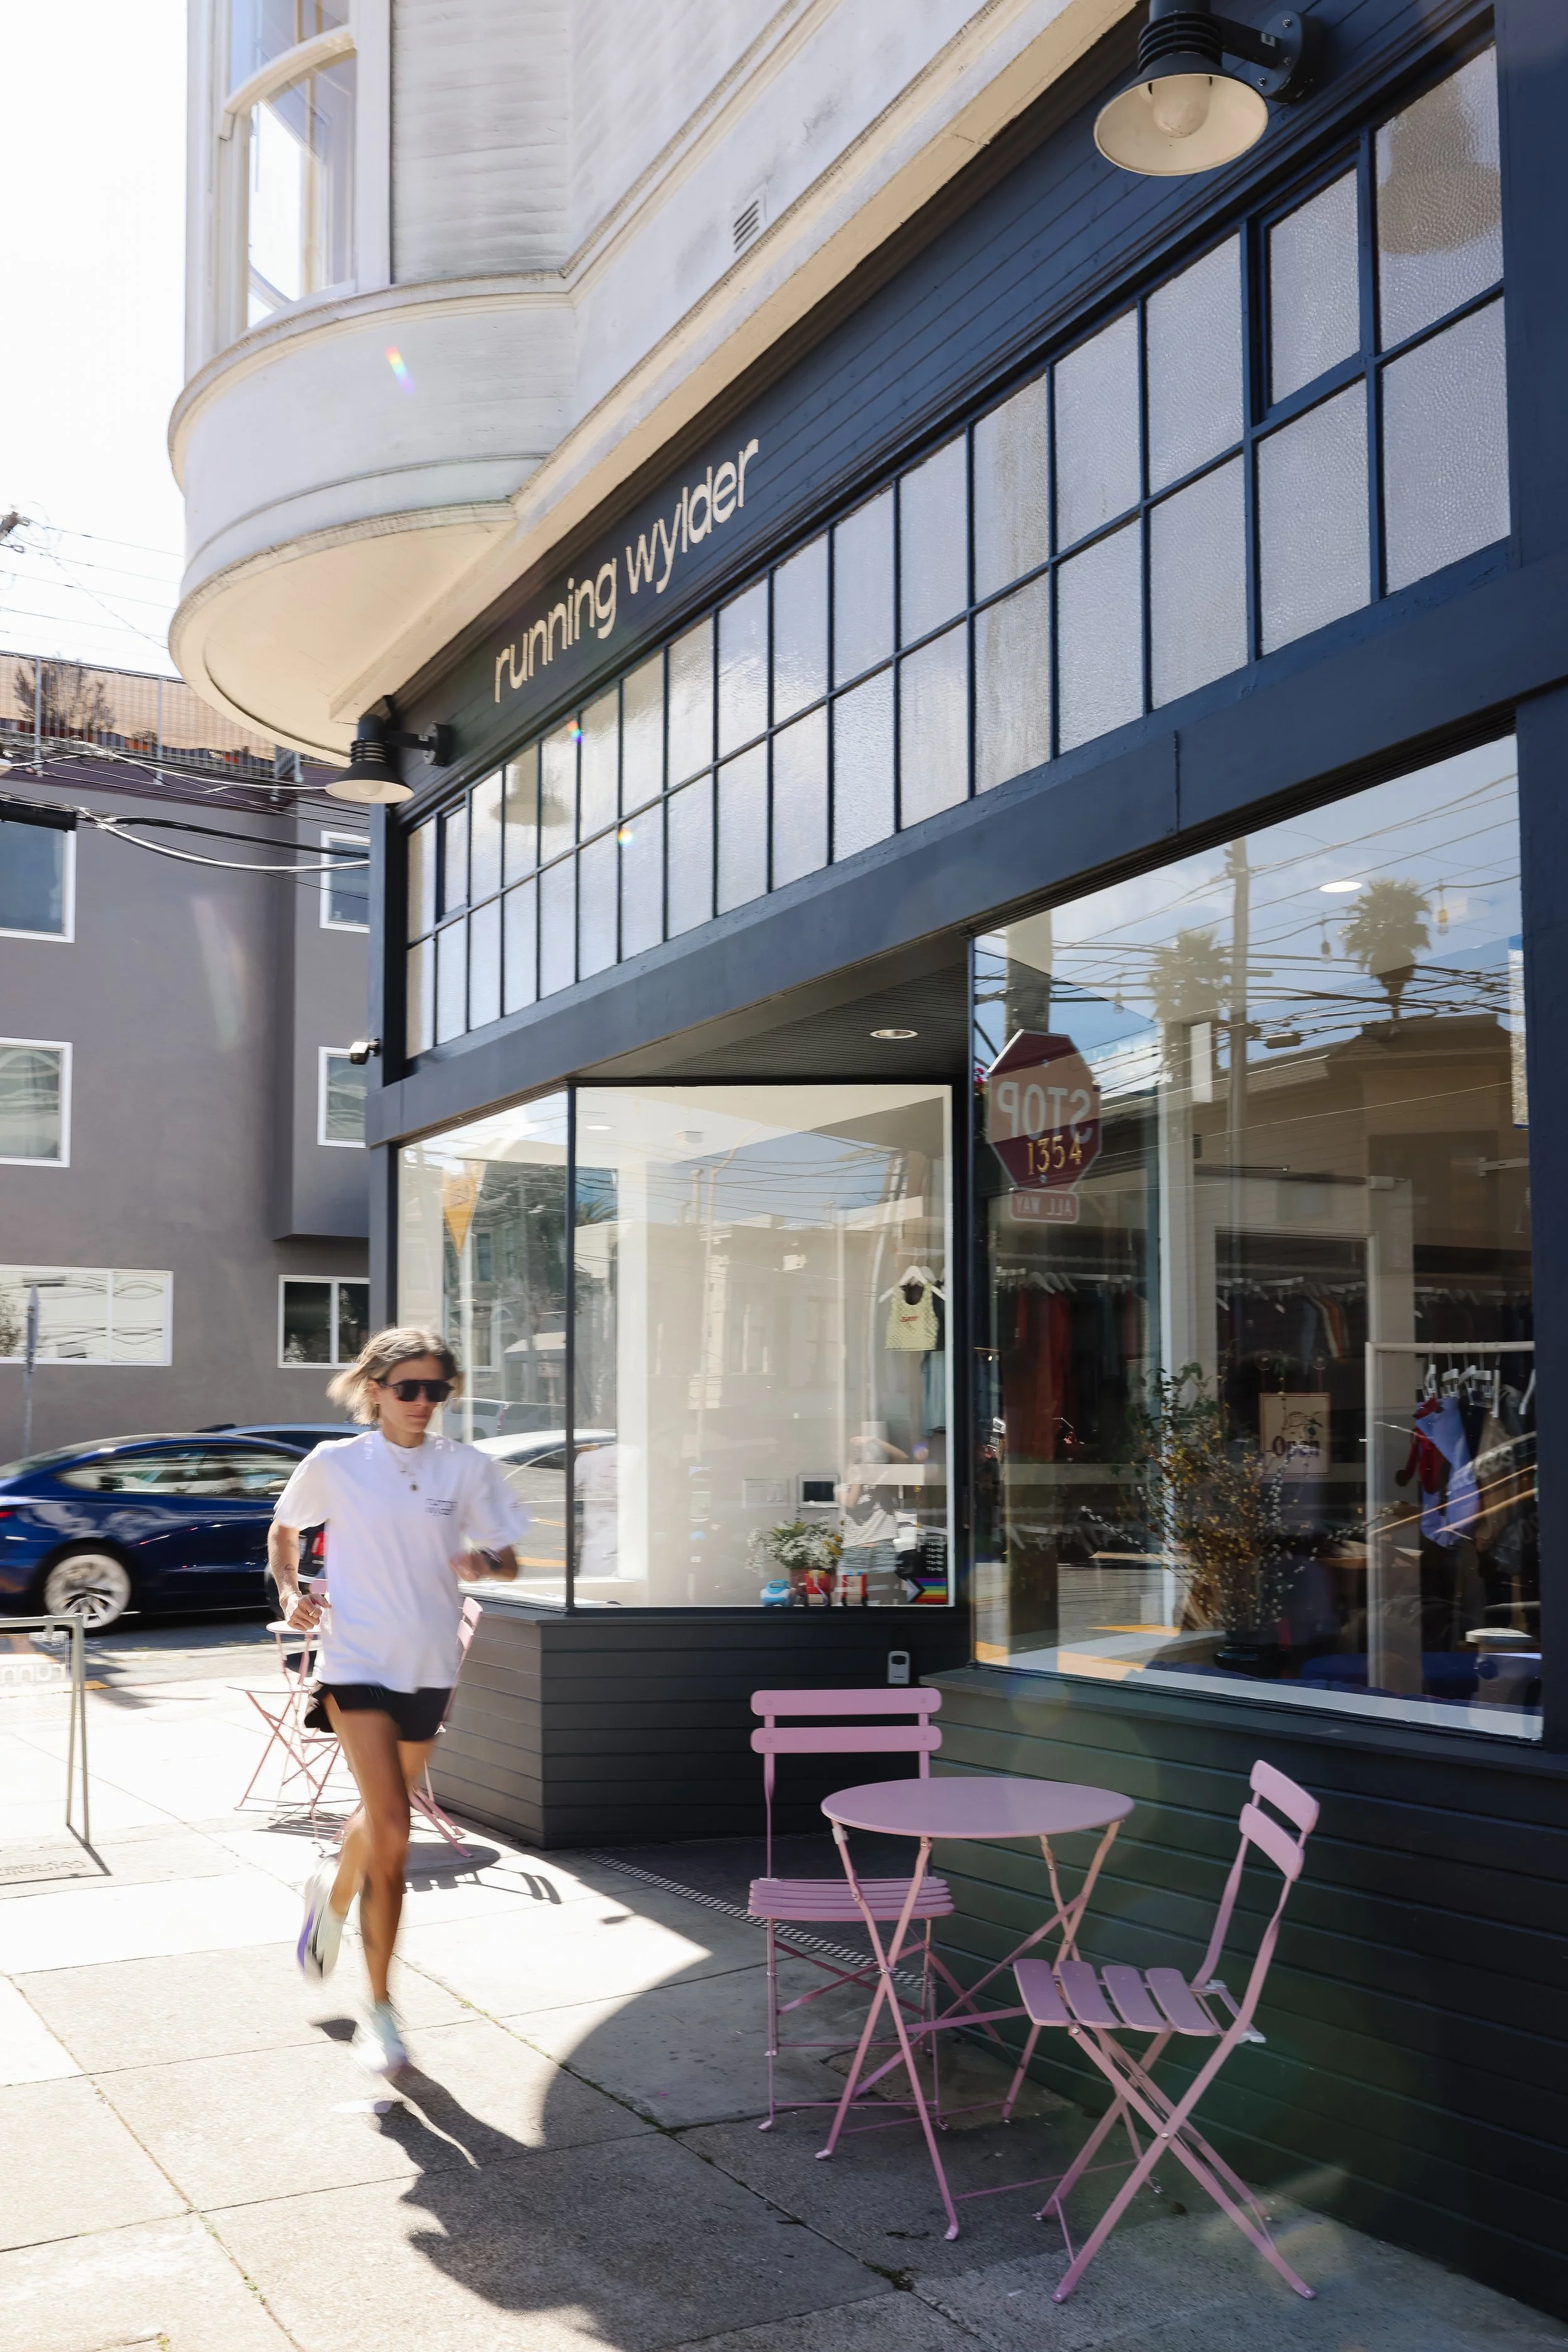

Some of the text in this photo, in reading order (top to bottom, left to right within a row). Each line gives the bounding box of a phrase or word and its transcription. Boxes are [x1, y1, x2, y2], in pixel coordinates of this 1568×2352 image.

[494, 439, 760, 703] running wylder
[1026, 1131, 1083, 1176] 1354
